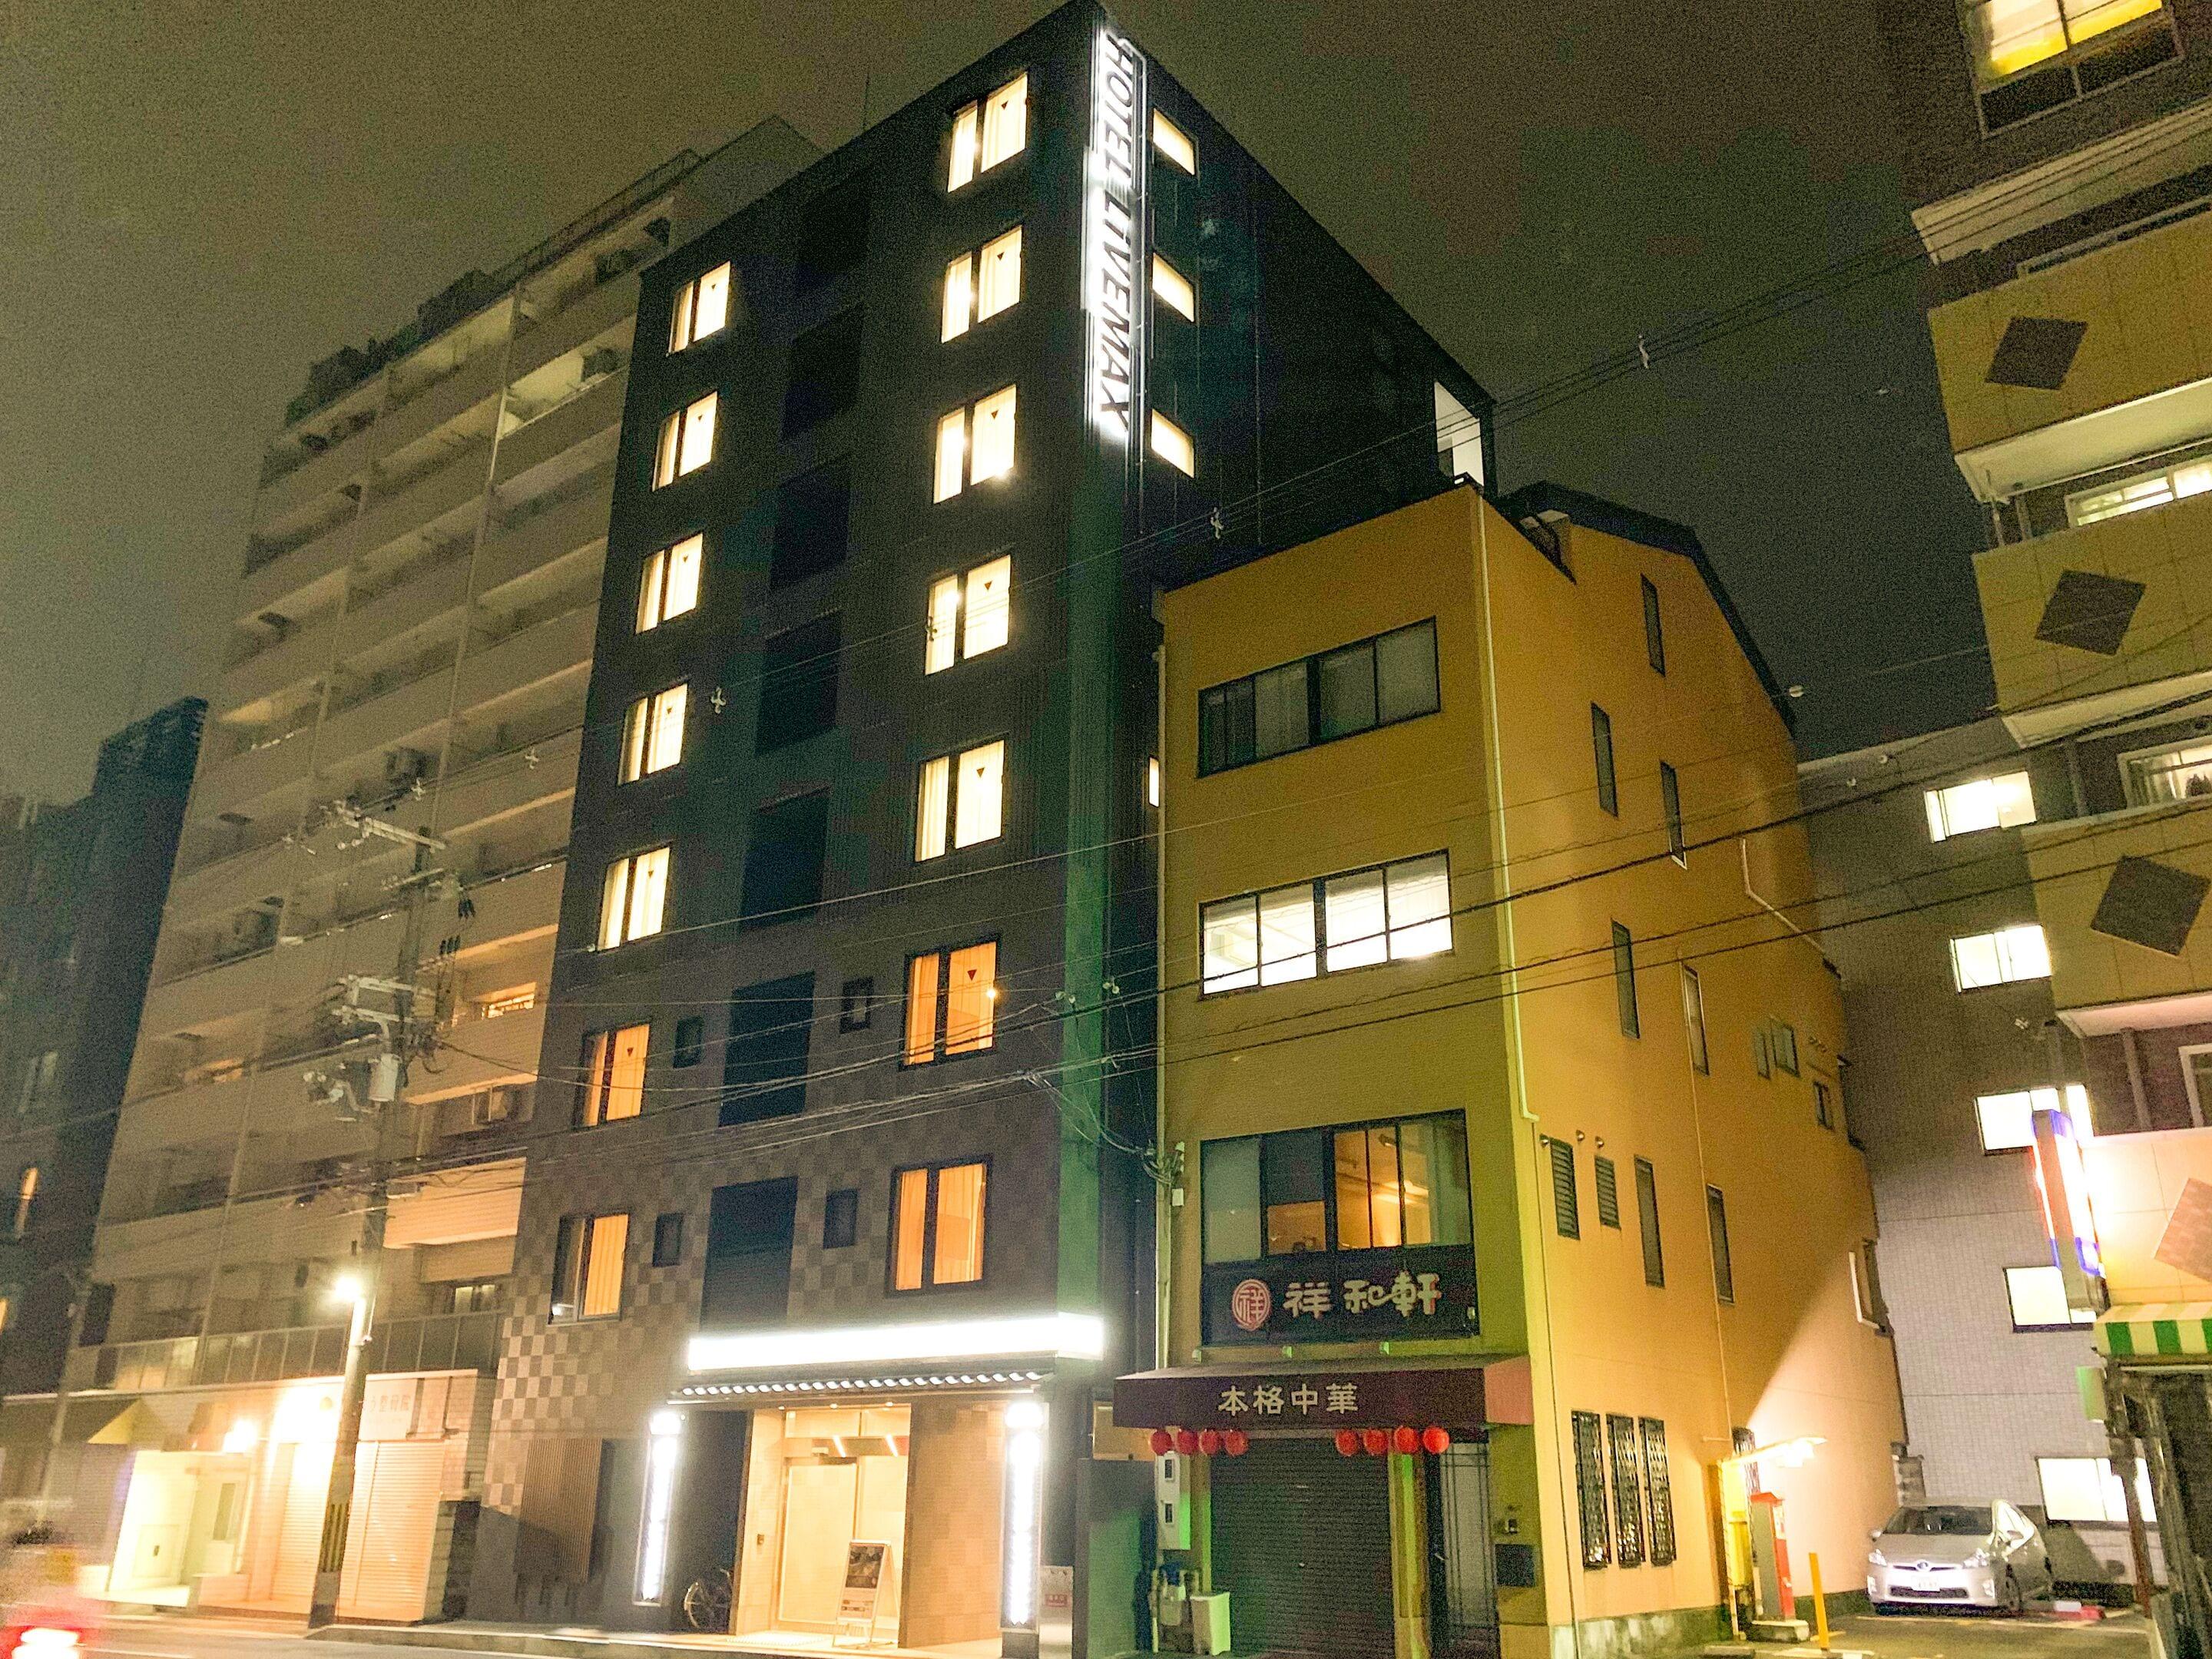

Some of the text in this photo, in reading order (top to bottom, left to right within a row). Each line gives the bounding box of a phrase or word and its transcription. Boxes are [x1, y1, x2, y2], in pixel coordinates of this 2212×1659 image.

[1104, 33, 1134, 178] HOTEL
[1283, 1270, 1442, 1318] 祥和軒
[1218, 1382, 1358, 1416] 本格中華
